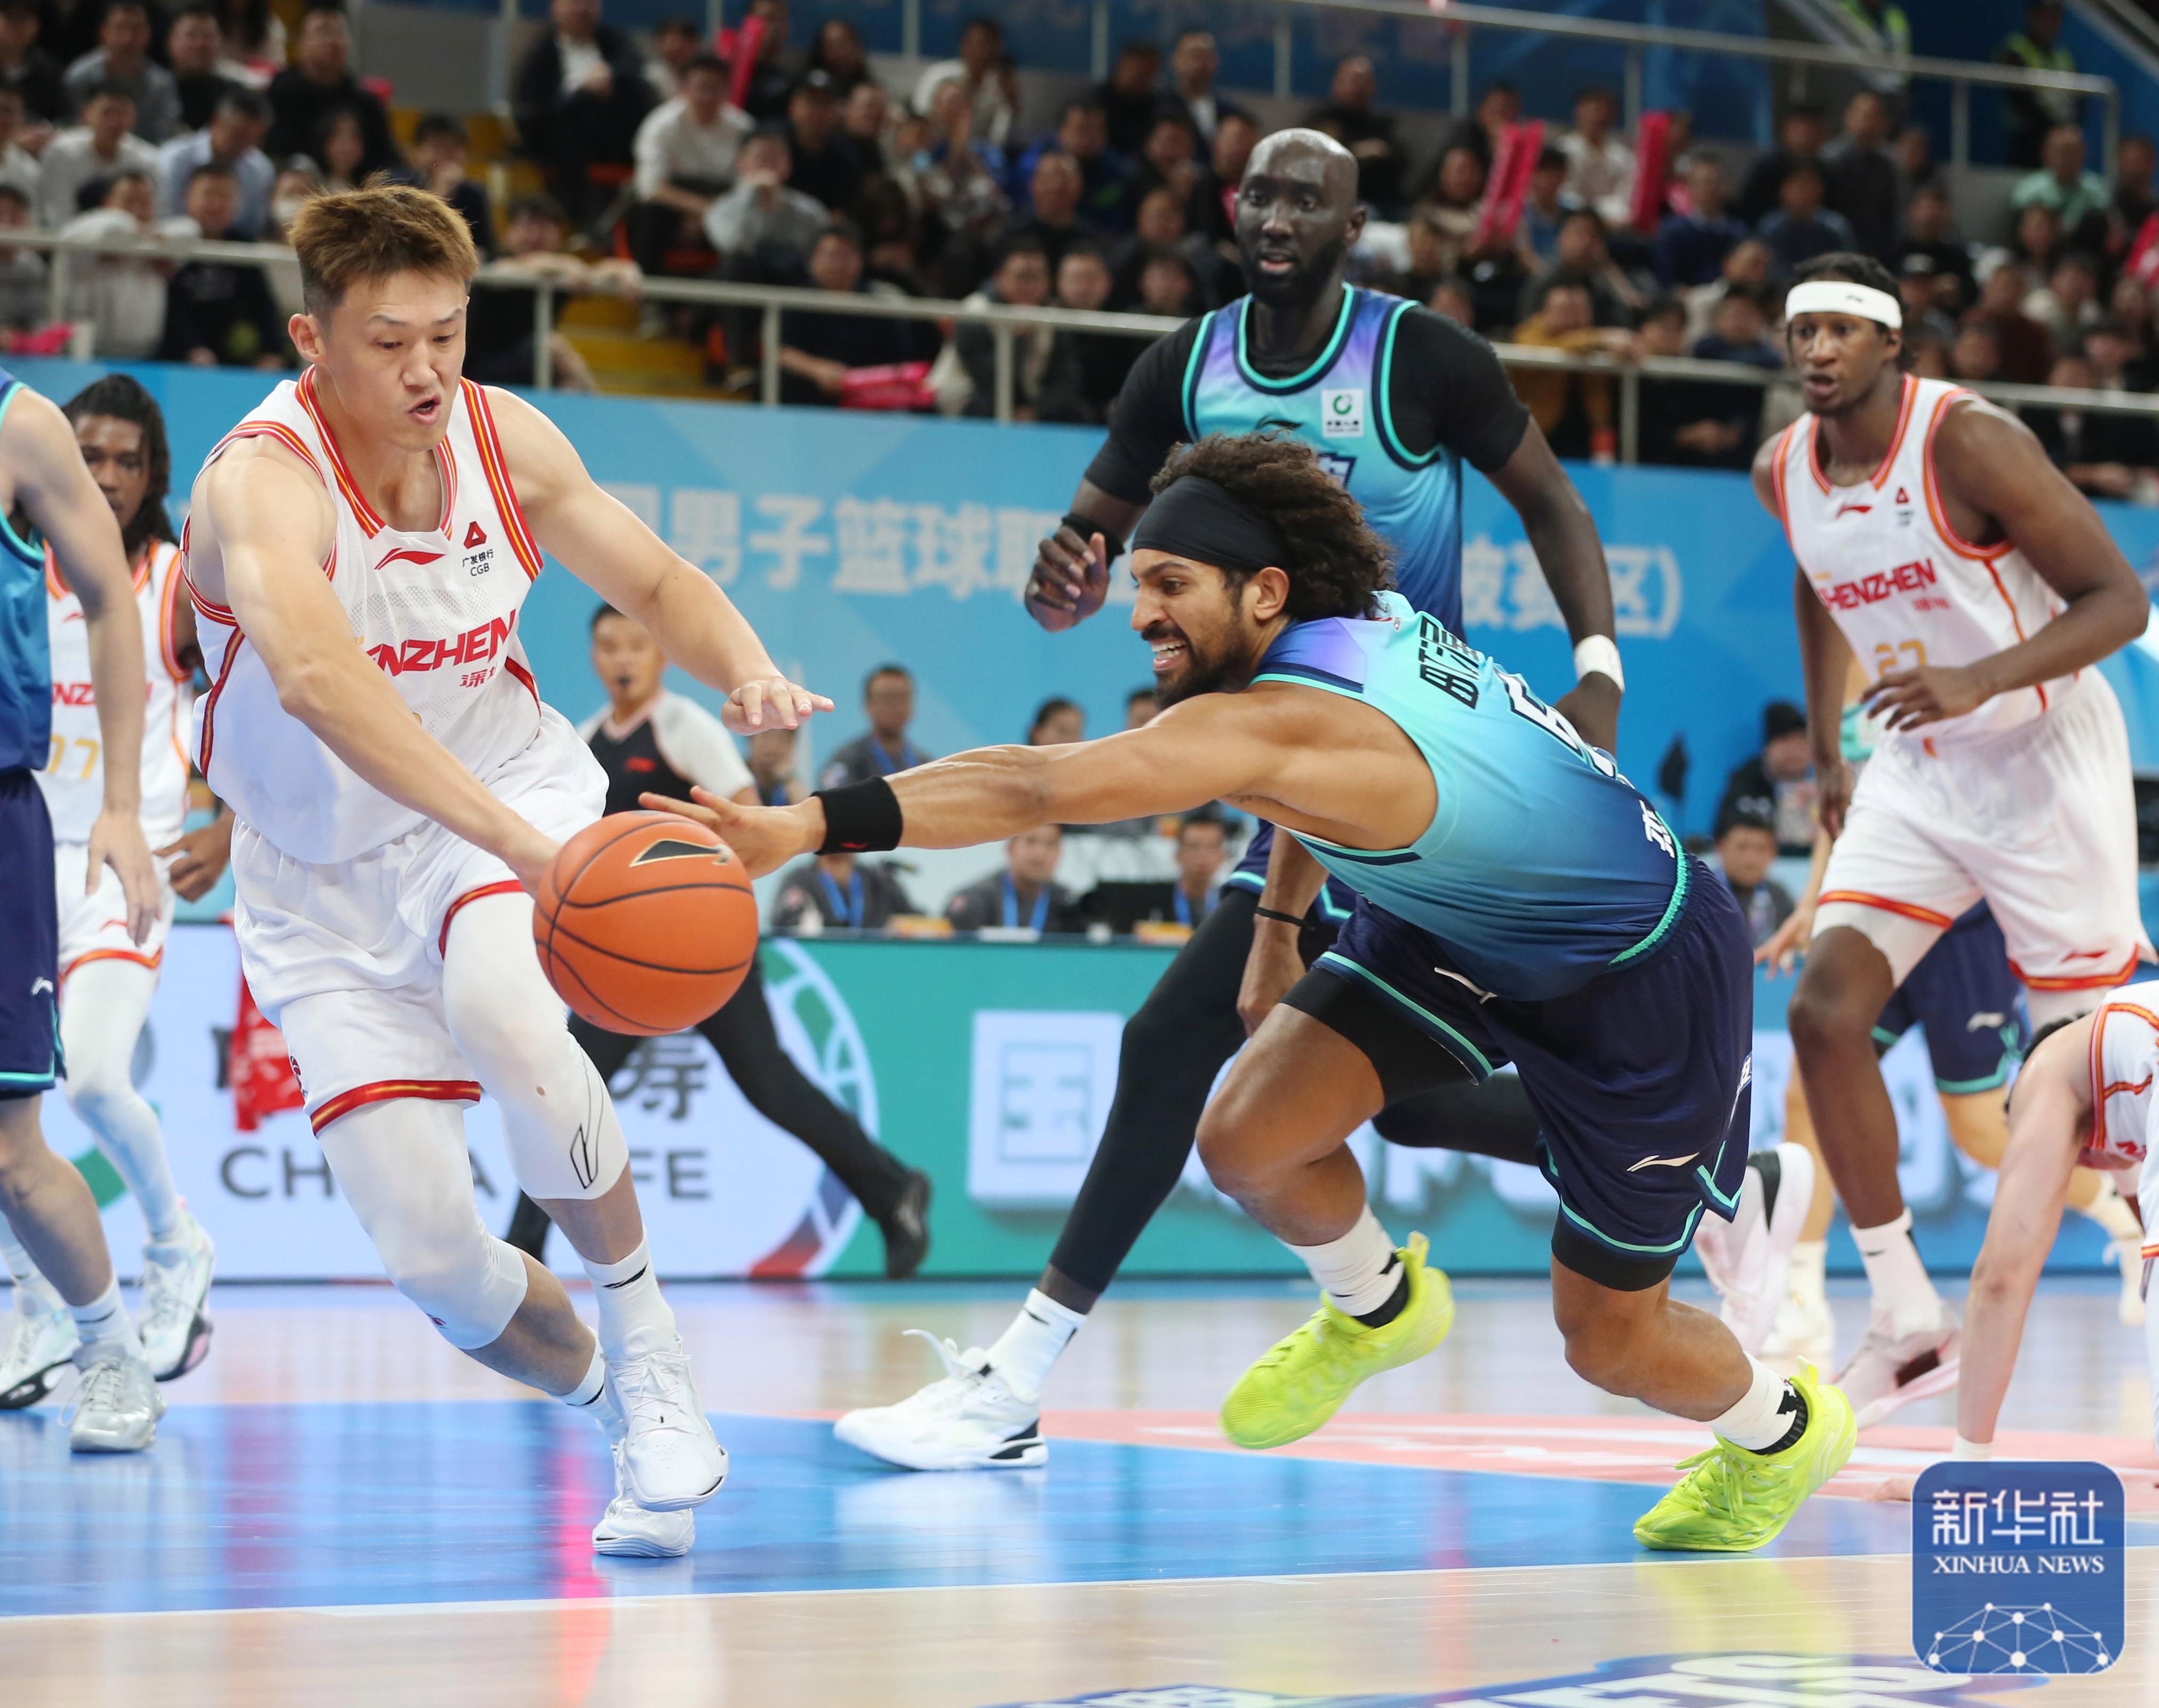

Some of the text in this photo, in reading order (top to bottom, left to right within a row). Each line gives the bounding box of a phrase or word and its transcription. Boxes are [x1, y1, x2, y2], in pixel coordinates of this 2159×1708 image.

[462, 548, 493, 568] 广发银行
[470, 562, 490, 577] CGB
